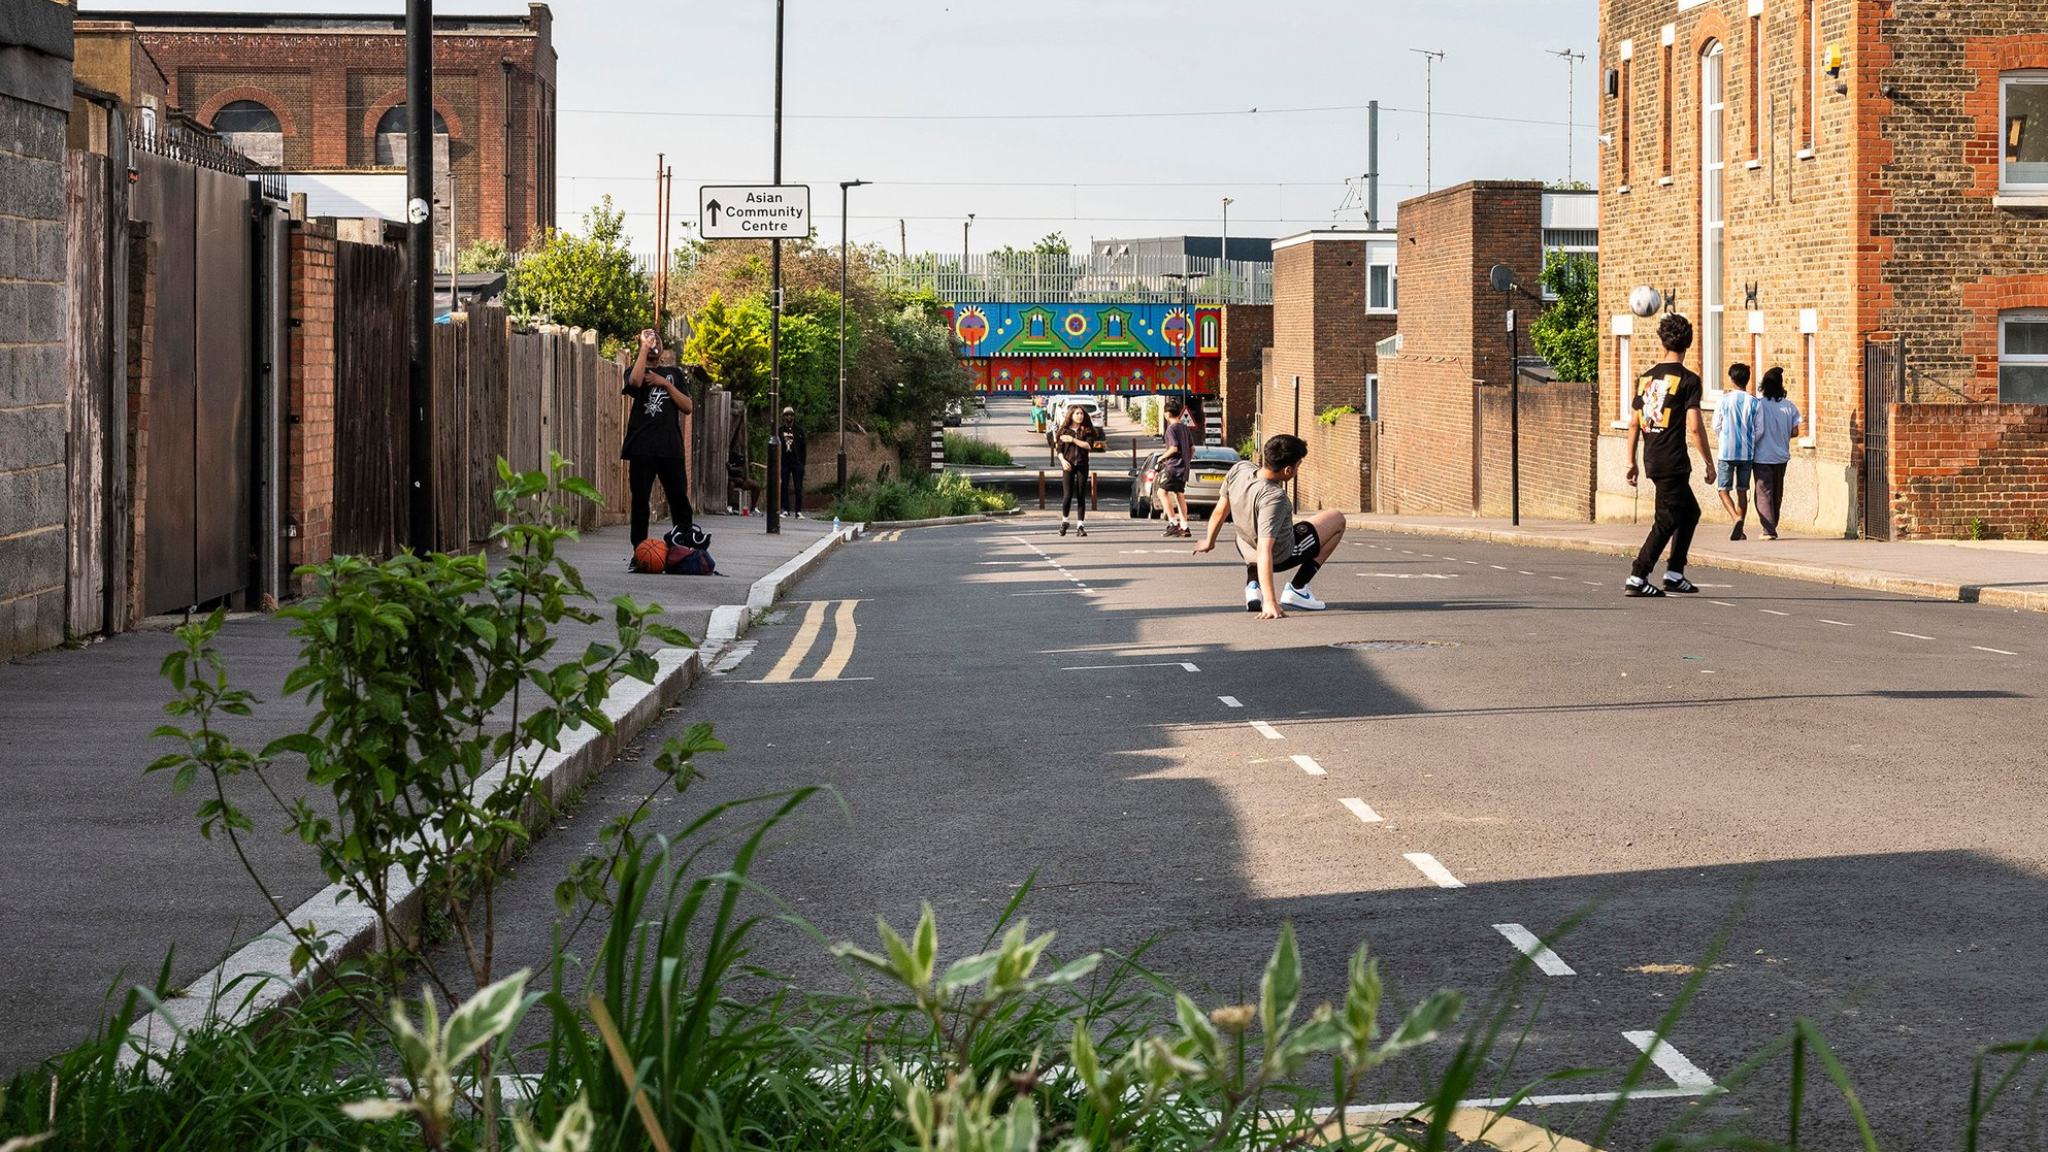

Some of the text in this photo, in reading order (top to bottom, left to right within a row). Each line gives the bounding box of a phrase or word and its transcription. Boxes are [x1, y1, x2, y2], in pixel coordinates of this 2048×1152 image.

[746, 192, 782, 203] Asian
[726, 206, 803, 219] Community
[742, 220, 787, 231] Centre
